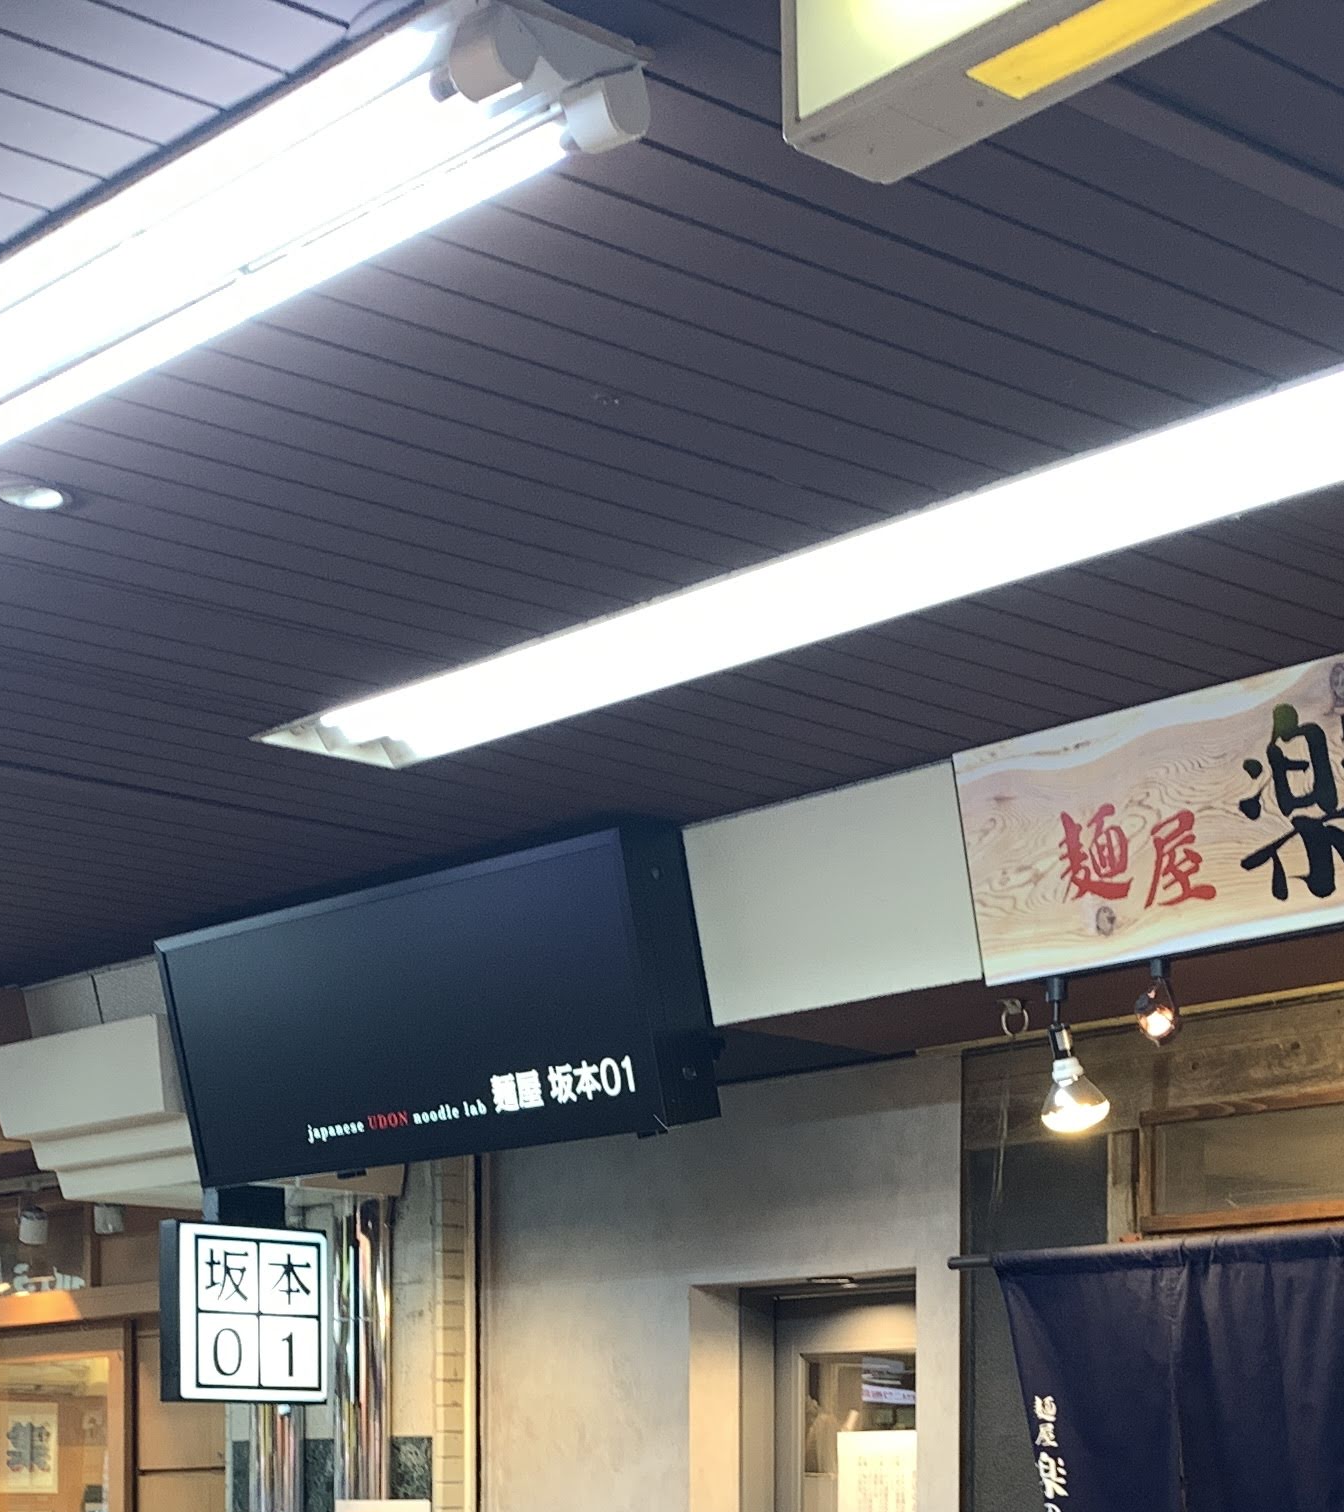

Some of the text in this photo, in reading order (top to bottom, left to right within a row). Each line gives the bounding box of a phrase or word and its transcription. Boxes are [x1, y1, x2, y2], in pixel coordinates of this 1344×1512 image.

[1057, 802, 1217, 908] 麺屋
[489, 1055, 637, 1113] 麺屋 坂本01
[306, 1098, 487, 1144] japanese UDON noodle lab
[204, 1249, 313, 1305] 坂本
[212, 1327, 297, 1379] 01
